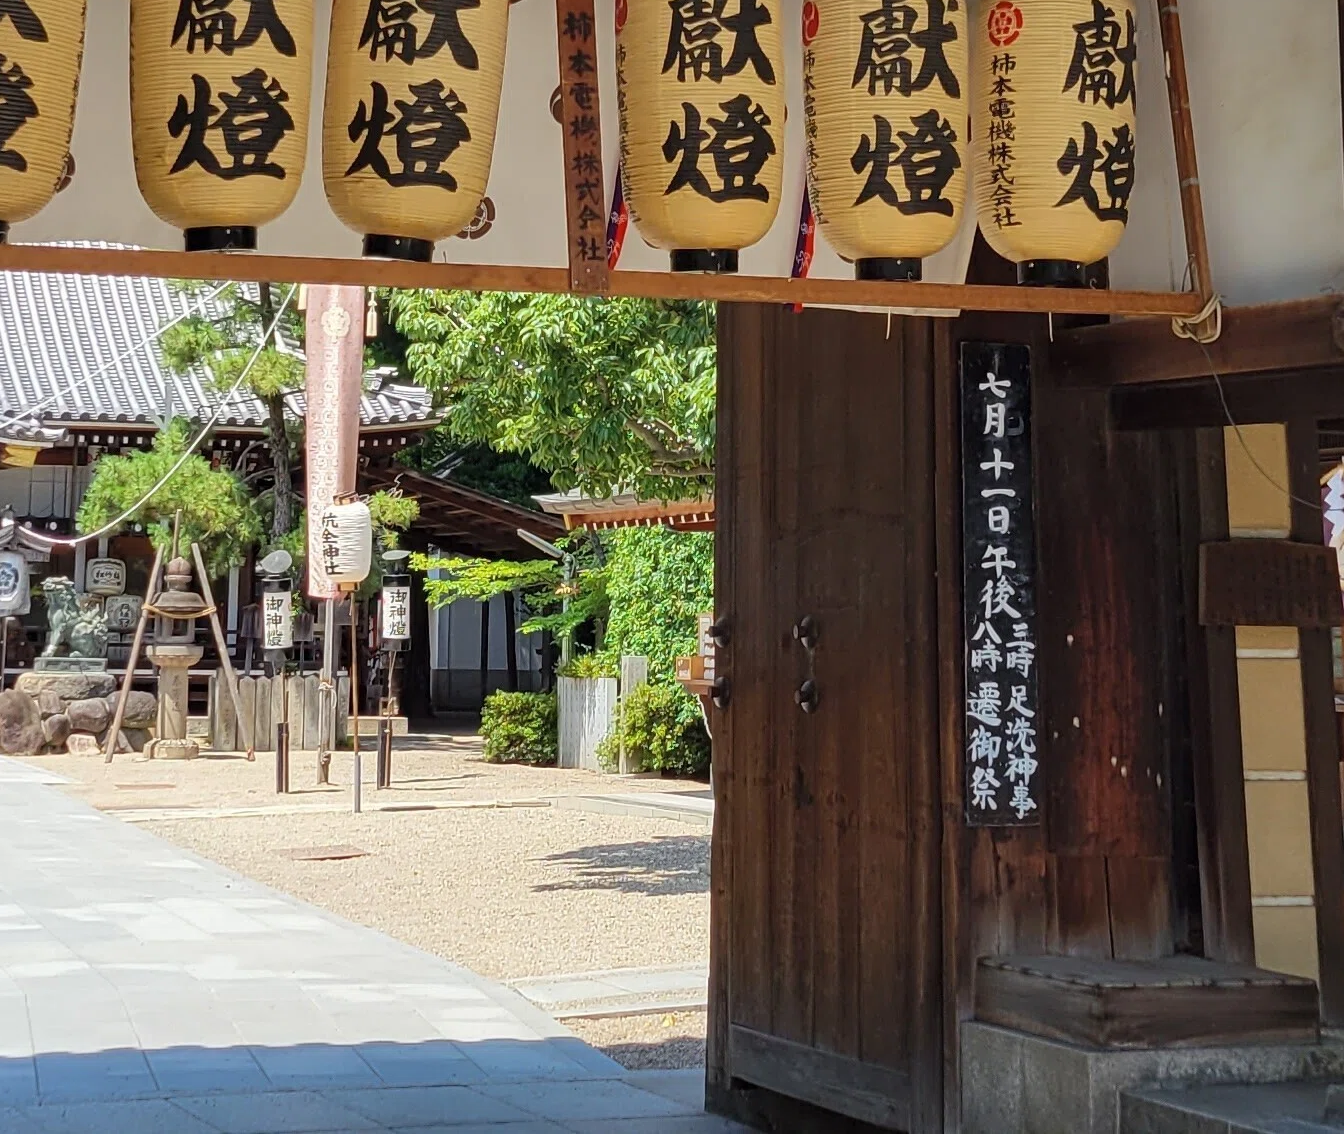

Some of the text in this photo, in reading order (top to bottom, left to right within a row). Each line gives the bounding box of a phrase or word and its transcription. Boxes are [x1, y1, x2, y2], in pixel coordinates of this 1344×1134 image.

[987, 53, 1022, 230] 柿本電機株式会社
